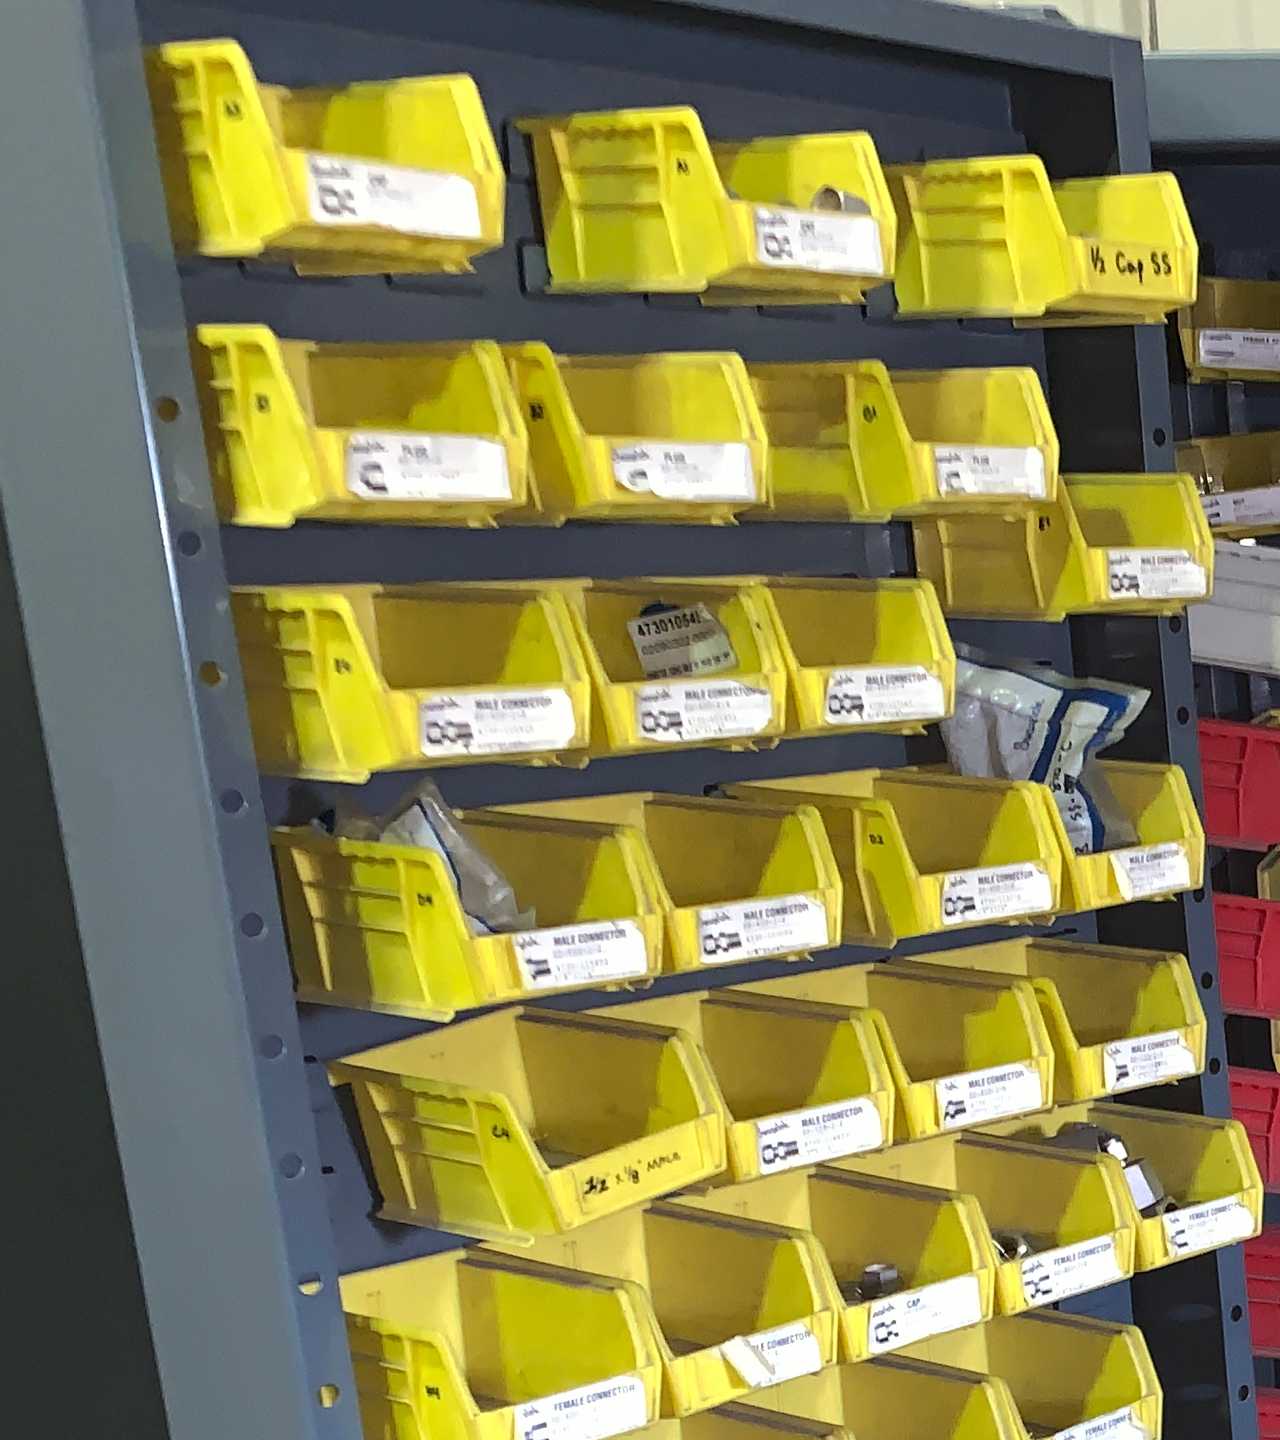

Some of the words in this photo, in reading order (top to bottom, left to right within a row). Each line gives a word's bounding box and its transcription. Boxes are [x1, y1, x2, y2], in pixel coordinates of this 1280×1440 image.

[1115, 250, 1144, 284] Cap
[1150, 251, 1172, 275] SS
[906, 1297, 921, 1309] CAP
